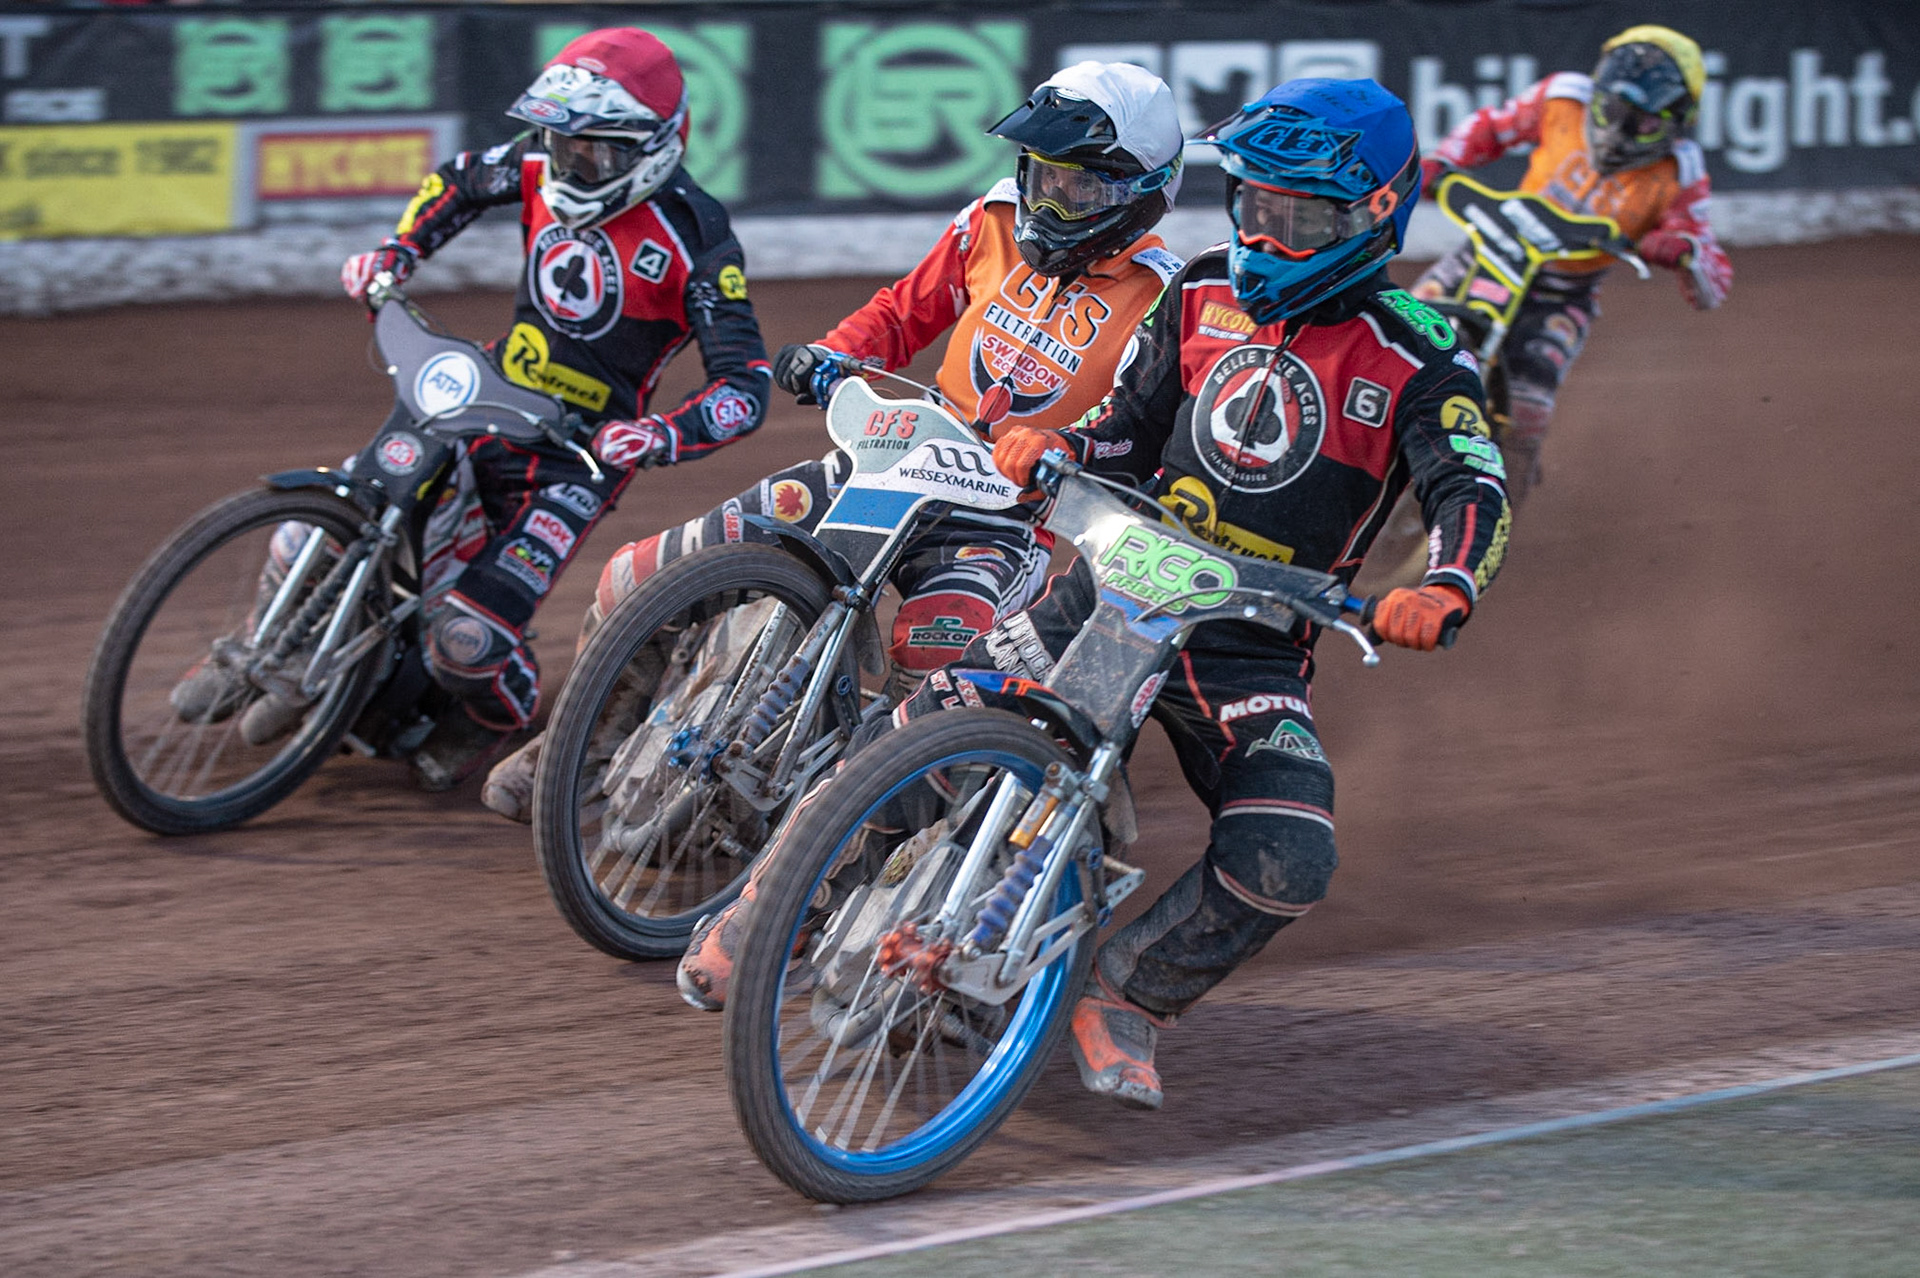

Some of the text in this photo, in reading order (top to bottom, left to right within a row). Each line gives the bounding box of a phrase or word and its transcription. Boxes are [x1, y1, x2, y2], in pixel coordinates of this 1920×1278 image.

[638, 250, 661, 276] 4
[1000, 261, 1111, 350] CFS
[985, 303, 1081, 374] FILTRATION
[983, 334, 1063, 389] SWINDON
[1214, 350, 1257, 386] BELLE
[1293, 381, 1318, 426] ACES
[1354, 387, 1381, 419] 6
[864, 409, 919, 440] CFS
[856, 438, 911, 451] FILTRATION
[898, 466, 1011, 498] WESSEXMARINE
[911, 631, 950, 642] ROCK
